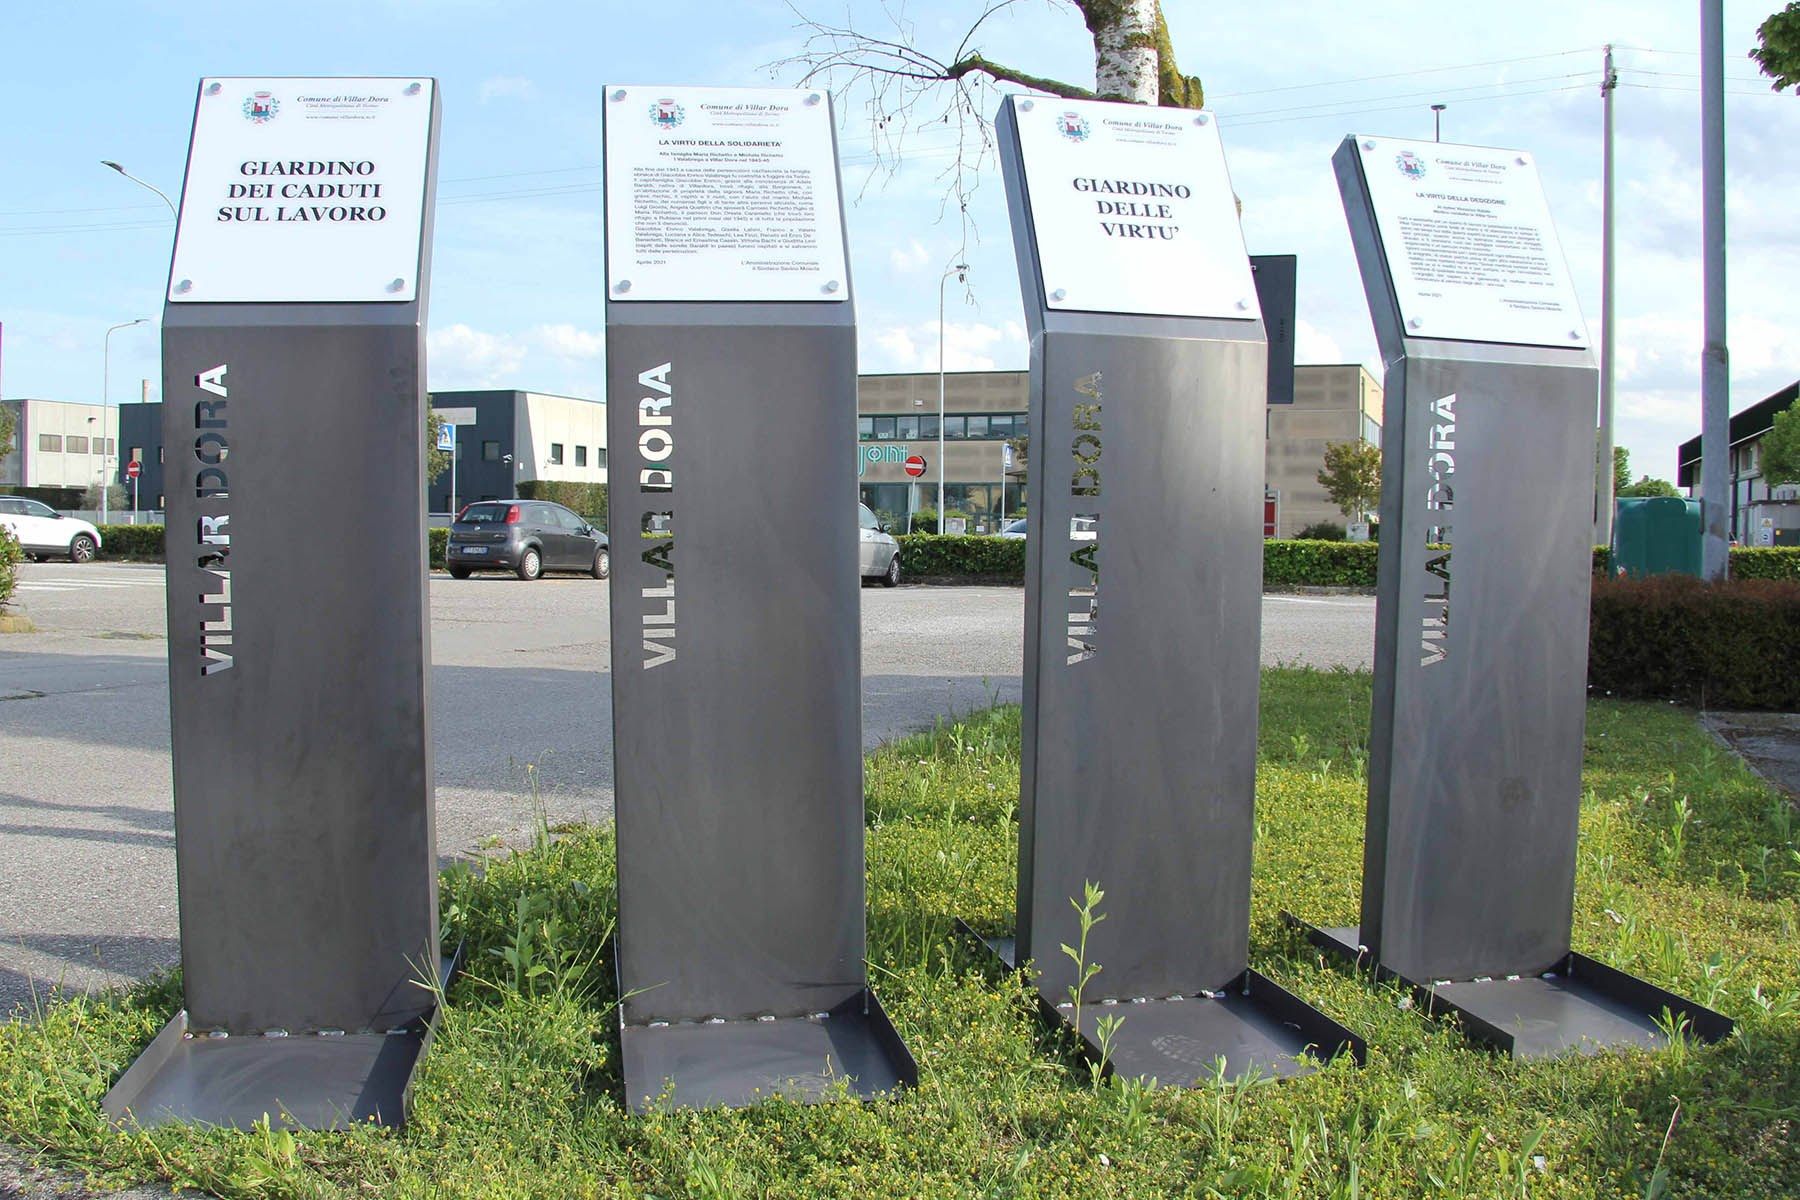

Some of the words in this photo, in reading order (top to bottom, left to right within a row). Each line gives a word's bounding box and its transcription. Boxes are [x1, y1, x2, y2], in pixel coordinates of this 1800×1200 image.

[1102, 119, 1132, 127] Comune
[229, 184, 274, 199] DEI
[281, 184, 382, 199] CADUTI
[240, 161, 375, 176] GIARDINO
[1073, 177, 1191, 199] GIARDINO
[1446, 193, 1469, 202] DELLA
[217, 206, 269, 222] SUL
[277, 206, 387, 222] LAVORO
[1096, 200, 1173, 219] DELLE
[1100, 222, 1180, 240] VIRTU'
[195, 364, 229, 499] DORA
[638, 362, 673, 493] DORA
[1072, 371, 1102, 497] DORA
[1427, 393, 1456, 510] DORA
[199, 515, 233, 676] VILLAR
[641, 511, 676, 670] VILLAR
[1067, 513, 1099, 666] VILLAR
[1421, 525, 1453, 667] VILLAR
